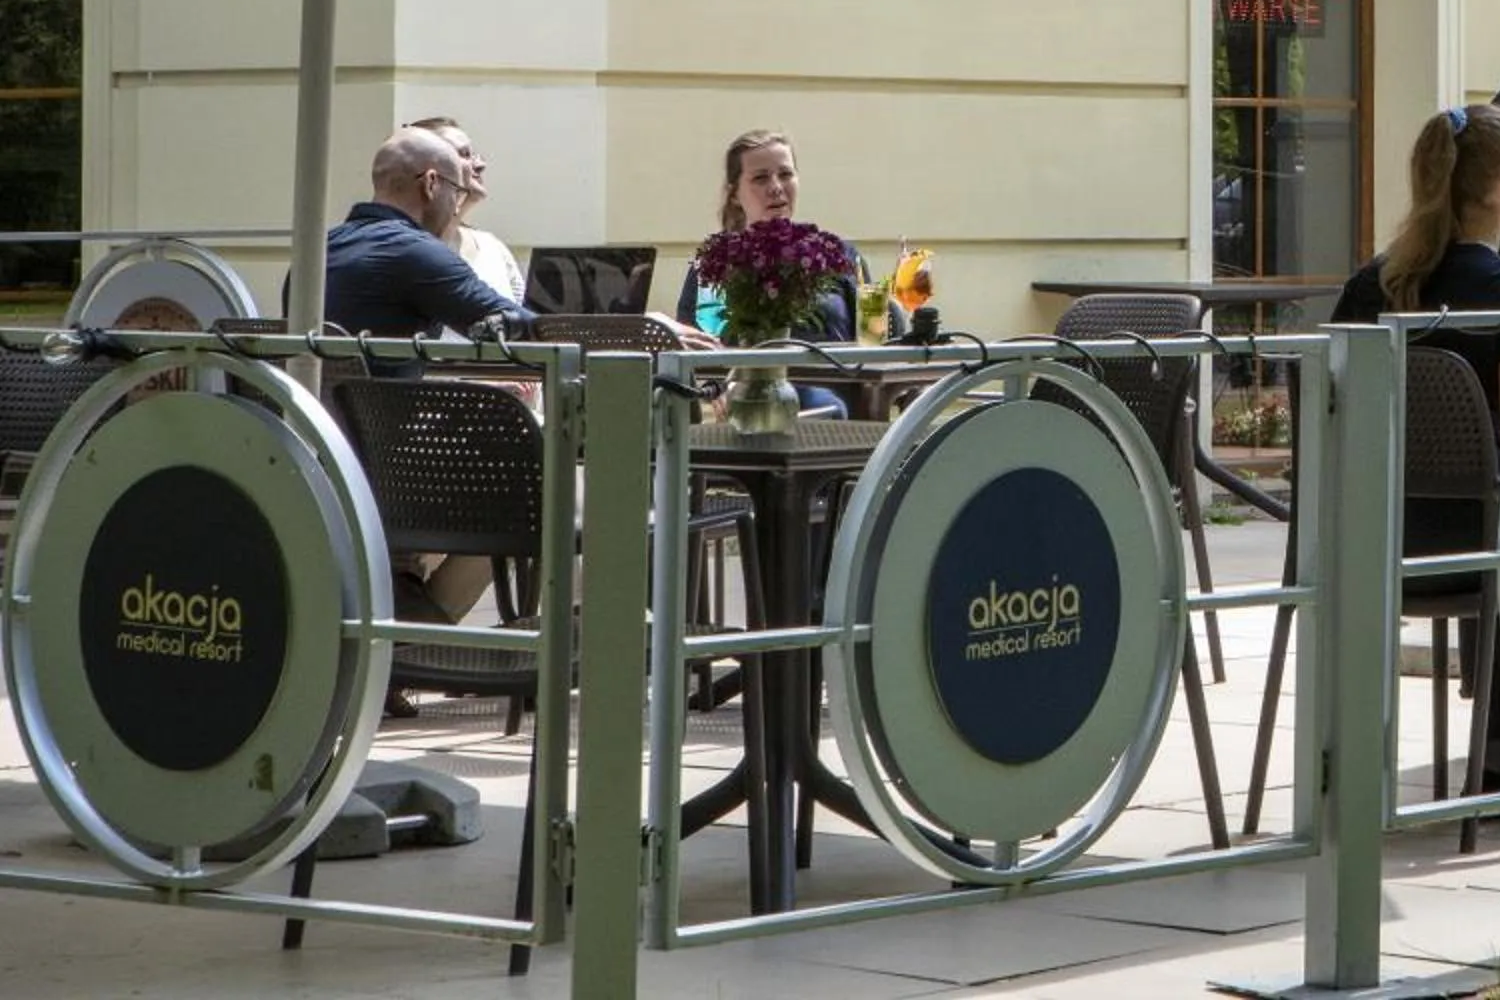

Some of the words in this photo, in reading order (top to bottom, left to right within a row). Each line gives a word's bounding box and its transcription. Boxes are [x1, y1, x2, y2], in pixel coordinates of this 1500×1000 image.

[122, 573, 241, 642] akacja
[968, 573, 1080, 632] akacja
[116, 630, 185, 657] medical
[188, 640, 242, 663] resort
[965, 628, 1029, 661] medical
[1033, 621, 1082, 650] resort
